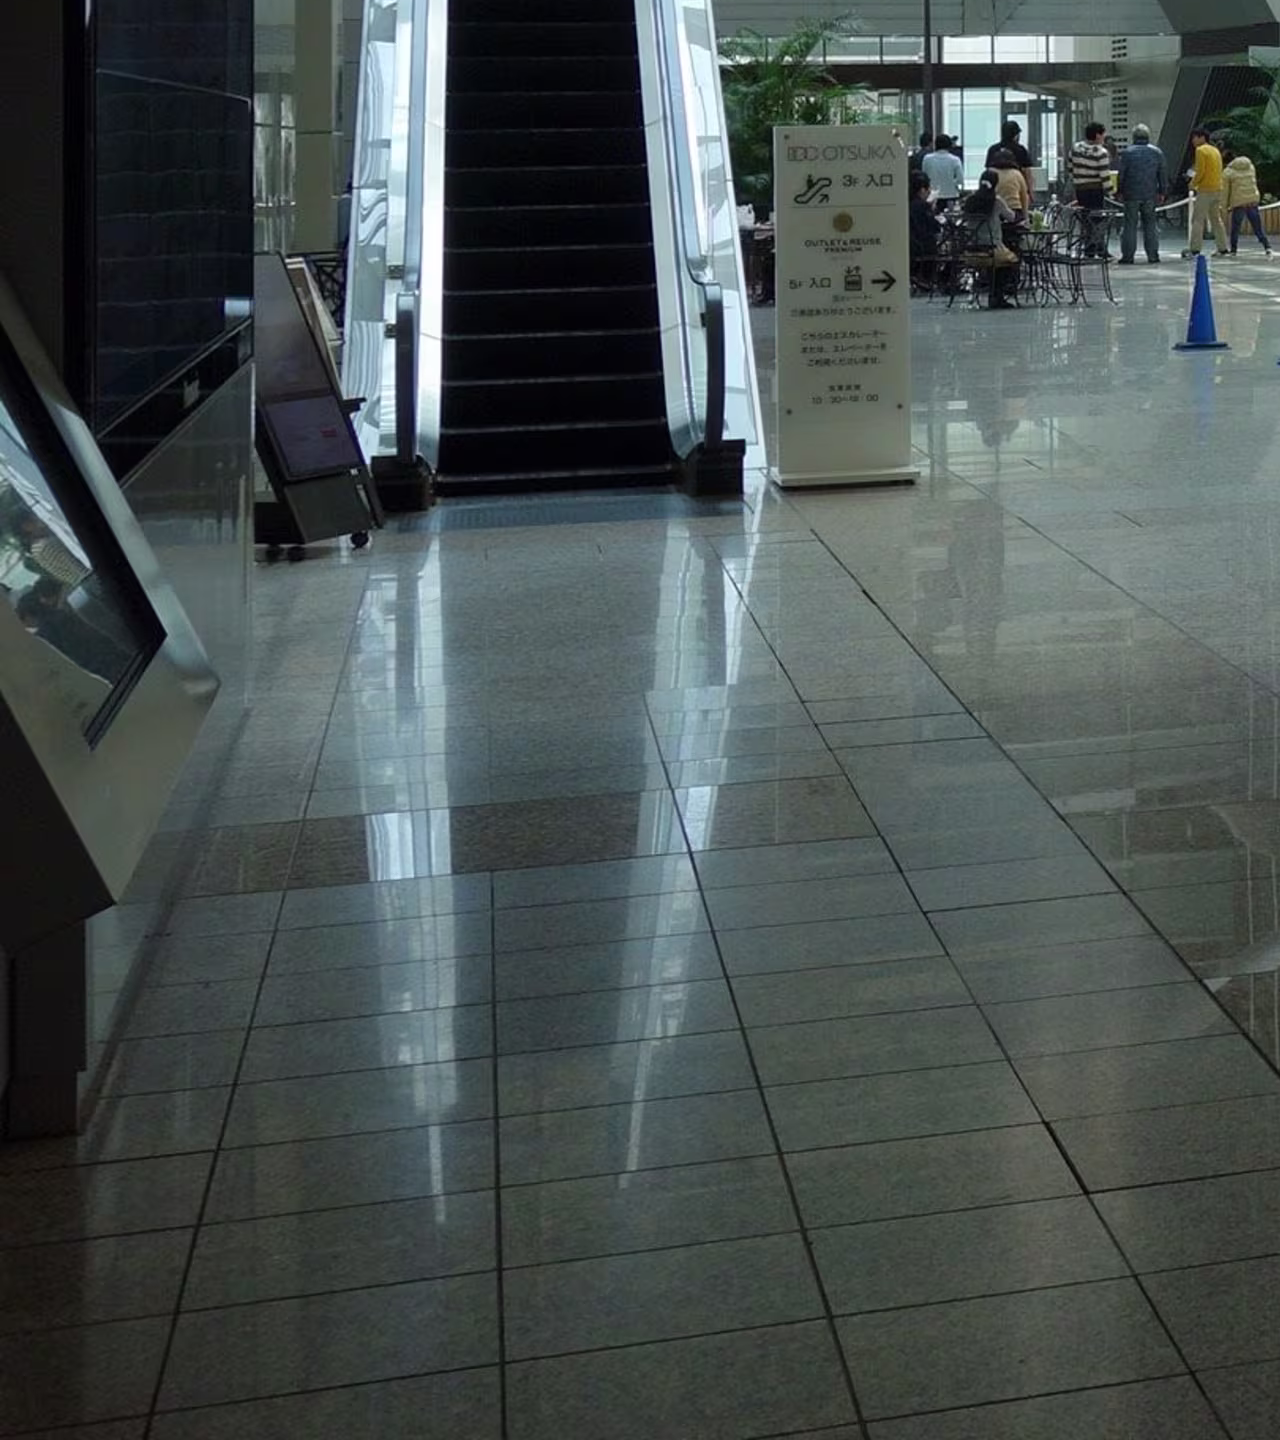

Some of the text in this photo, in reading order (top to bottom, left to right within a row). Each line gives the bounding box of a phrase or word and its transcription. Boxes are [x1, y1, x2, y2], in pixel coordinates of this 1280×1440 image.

[822, 144, 896, 161] OTSUKA
[842, 173, 894, 188] 3F 入口
[808, 277, 833, 289] 入口
